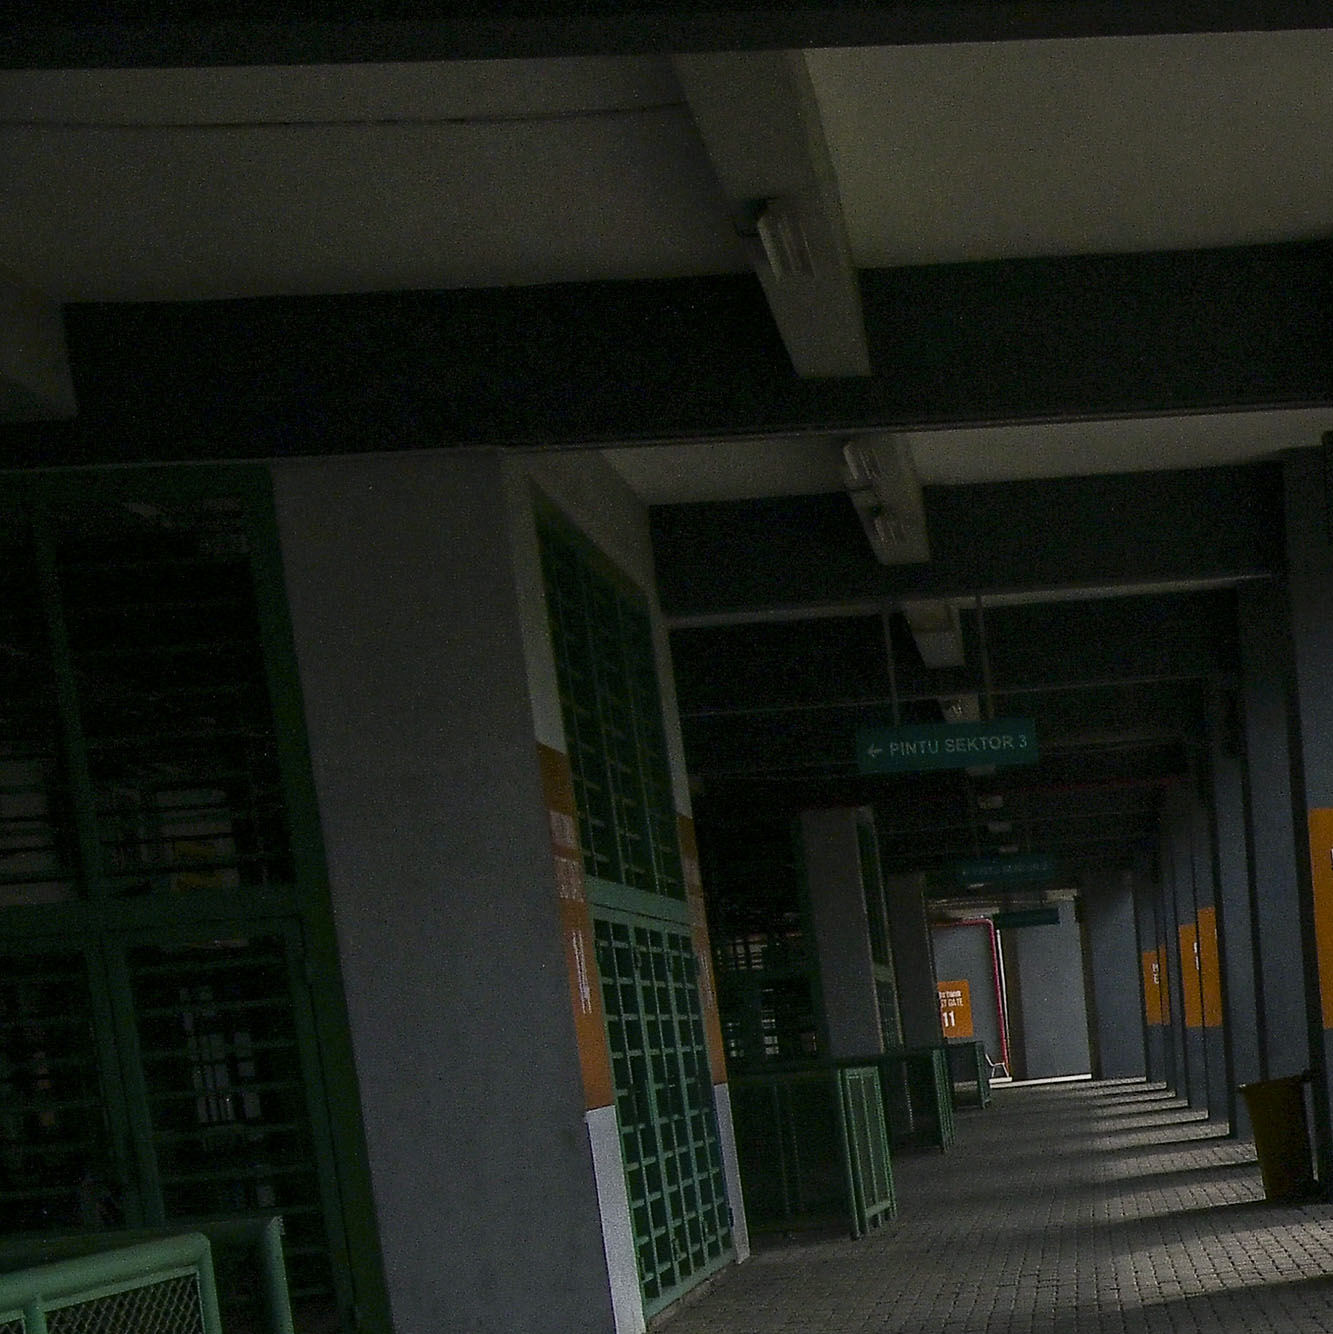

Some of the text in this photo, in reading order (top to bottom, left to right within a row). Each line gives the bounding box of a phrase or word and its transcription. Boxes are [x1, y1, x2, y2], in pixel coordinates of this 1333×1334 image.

[889, 734, 1029, 756] PINTU SEKTOR 3
[943, 1011, 956, 1027] 11
